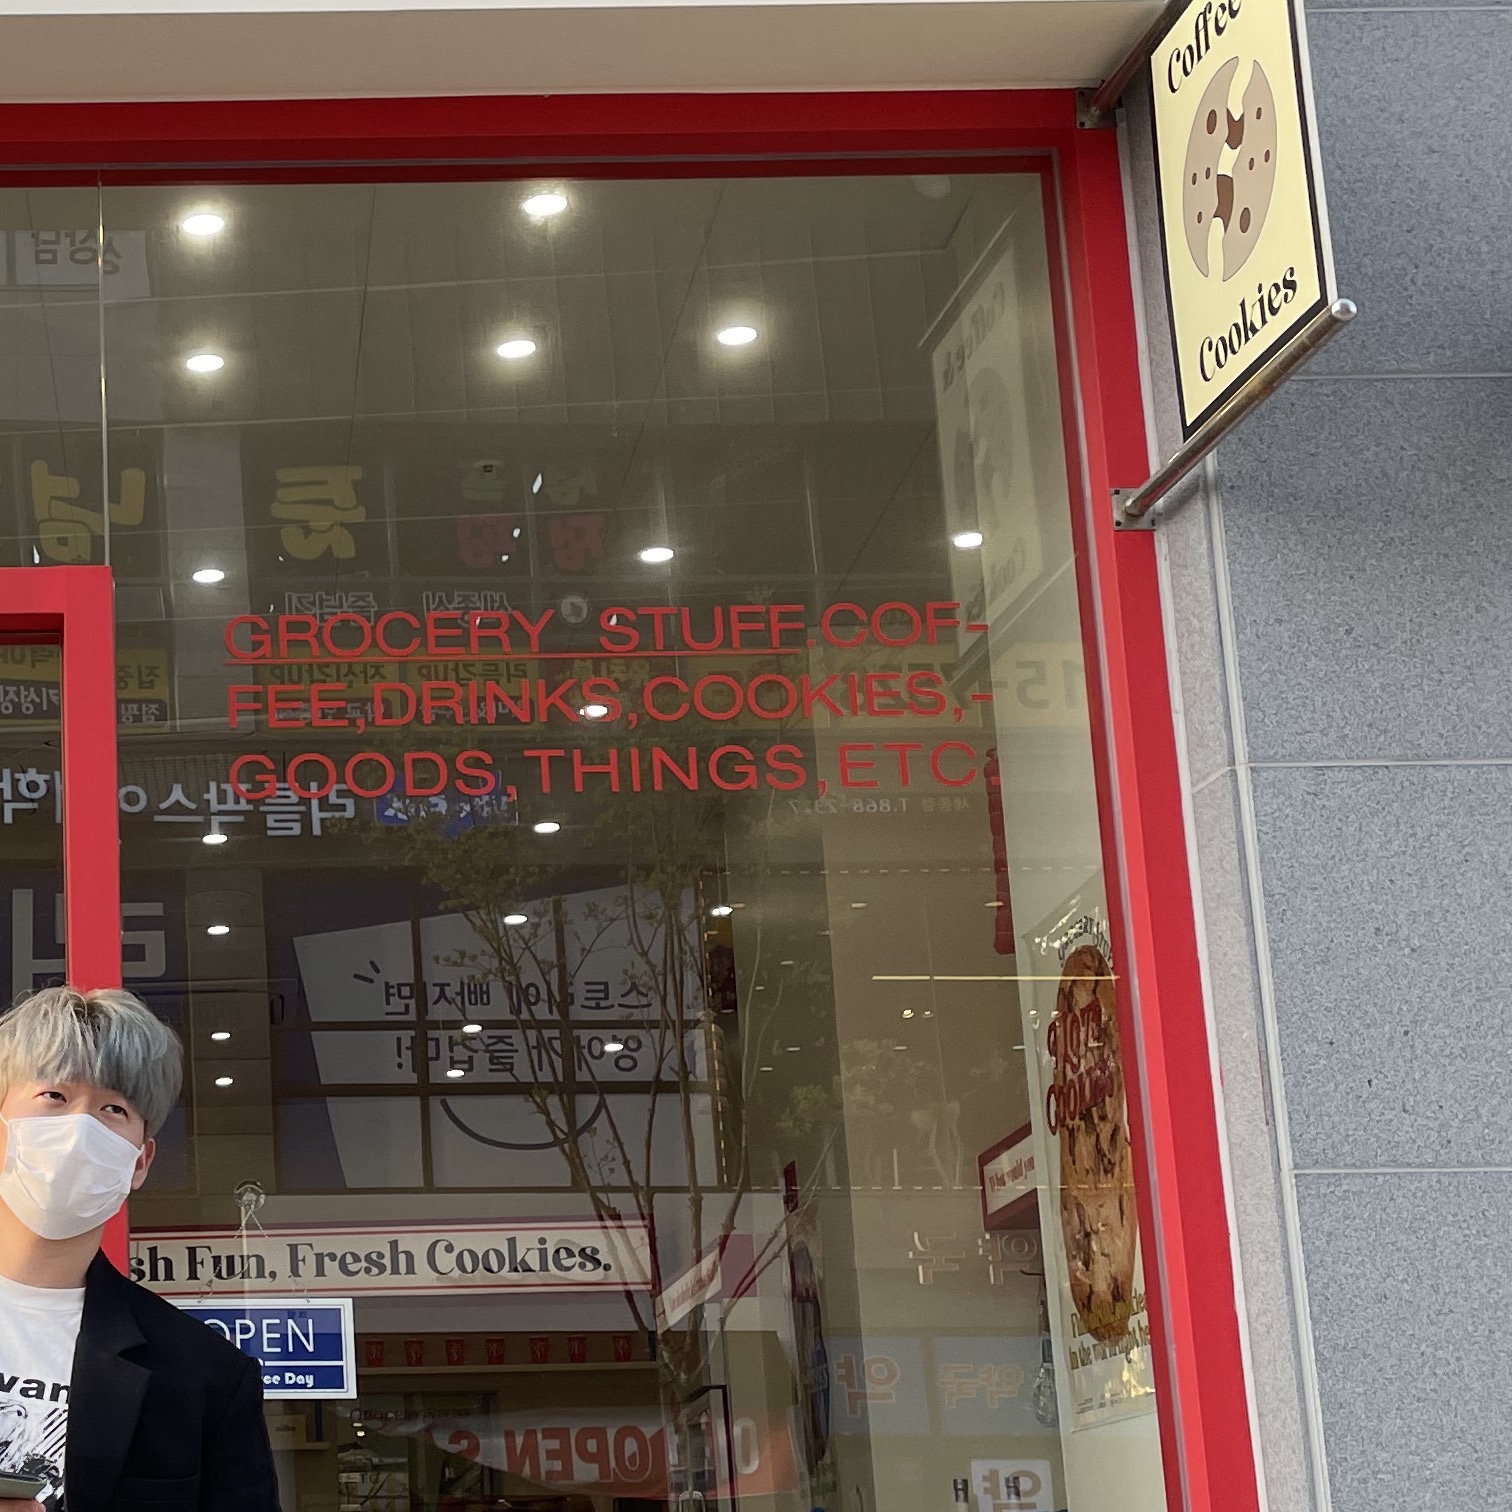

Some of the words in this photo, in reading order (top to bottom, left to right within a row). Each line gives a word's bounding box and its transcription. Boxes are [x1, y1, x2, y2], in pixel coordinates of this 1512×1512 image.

[1166, 0, 1244, 95] Coffee
[1199, 266, 1299, 384] Cookies
[223, 608, 556, 661] GROCERY
[186, 1245, 278, 1284] Fun,
[286, 1239, 418, 1280] Fresh
[427, 1236, 613, 1277] Cookies.
[284, 1372, 314, 1388] Day
